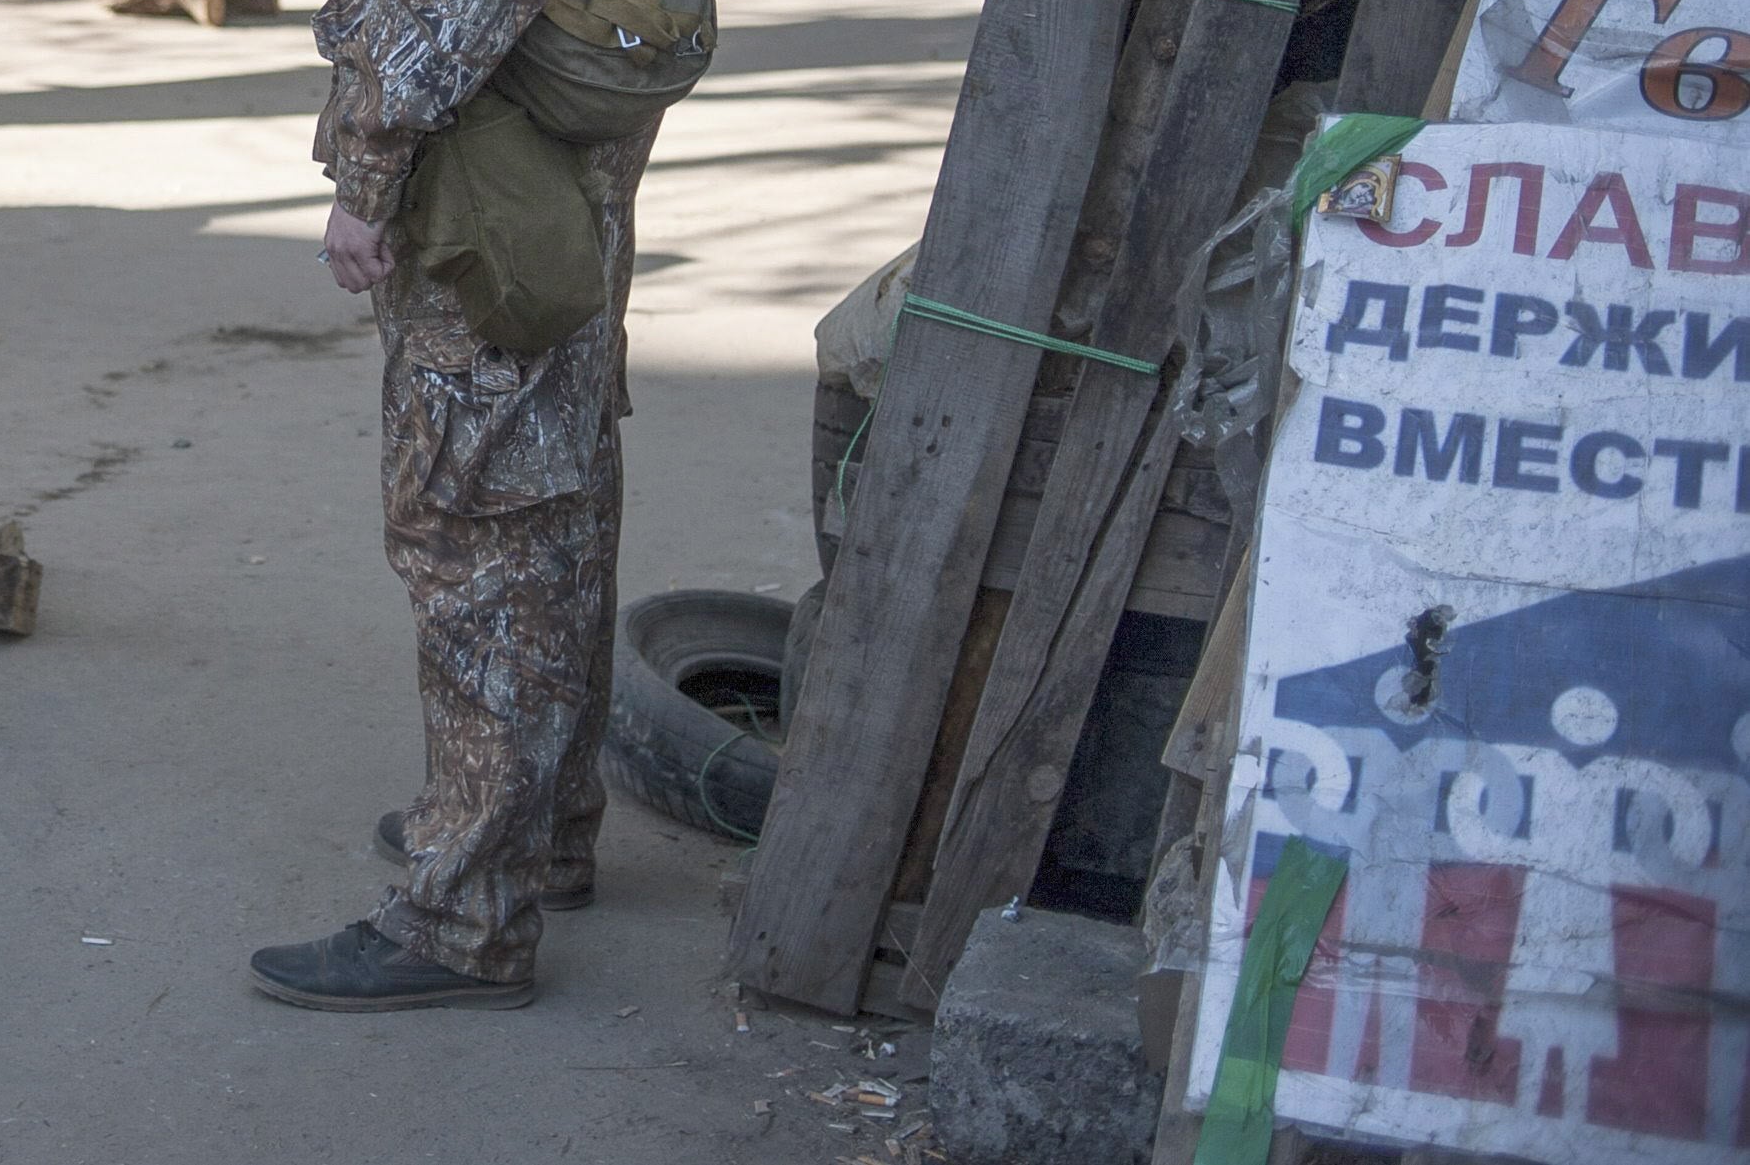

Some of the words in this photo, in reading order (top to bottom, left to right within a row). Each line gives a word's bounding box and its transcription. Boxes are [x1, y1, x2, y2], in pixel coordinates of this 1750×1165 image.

[1356, 160, 1750, 276] СЛАВ
[1325, 280, 1750, 383] ДЕРЖИ
[1313, 396, 1750, 514] ВМЕСТ
